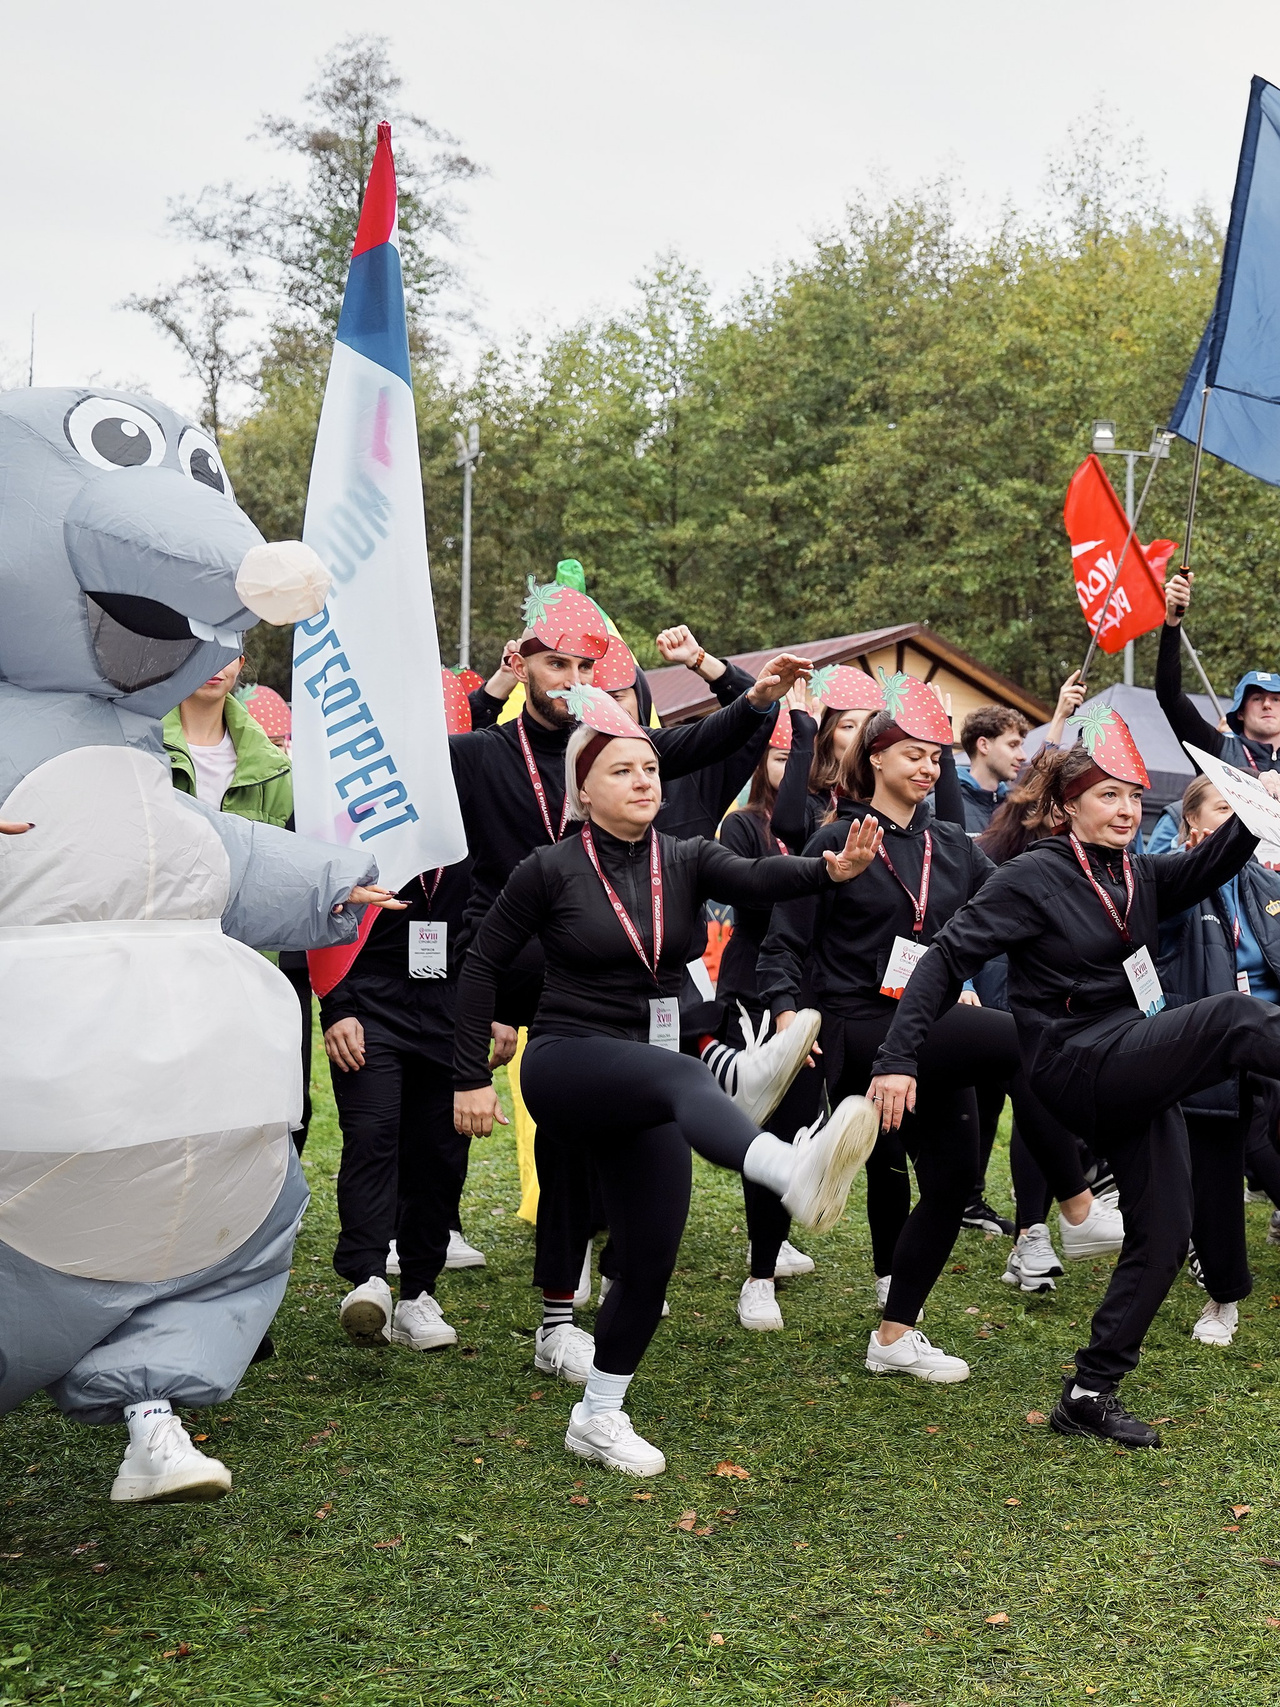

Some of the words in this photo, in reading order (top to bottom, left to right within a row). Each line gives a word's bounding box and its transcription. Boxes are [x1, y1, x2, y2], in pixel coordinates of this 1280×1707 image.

[525, 754, 537, 775] ГОРОДА
[538, 796, 551, 826] ФУНДАМЕНТ
[1075, 842, 1086, 861] ГОРОДА
[1109, 909, 1125, 932] ГОРОДА
[419, 932, 438, 940] XVIII
[1133, 962, 1148, 978] XVIII
[656, 1014, 672, 1024] XVIII
